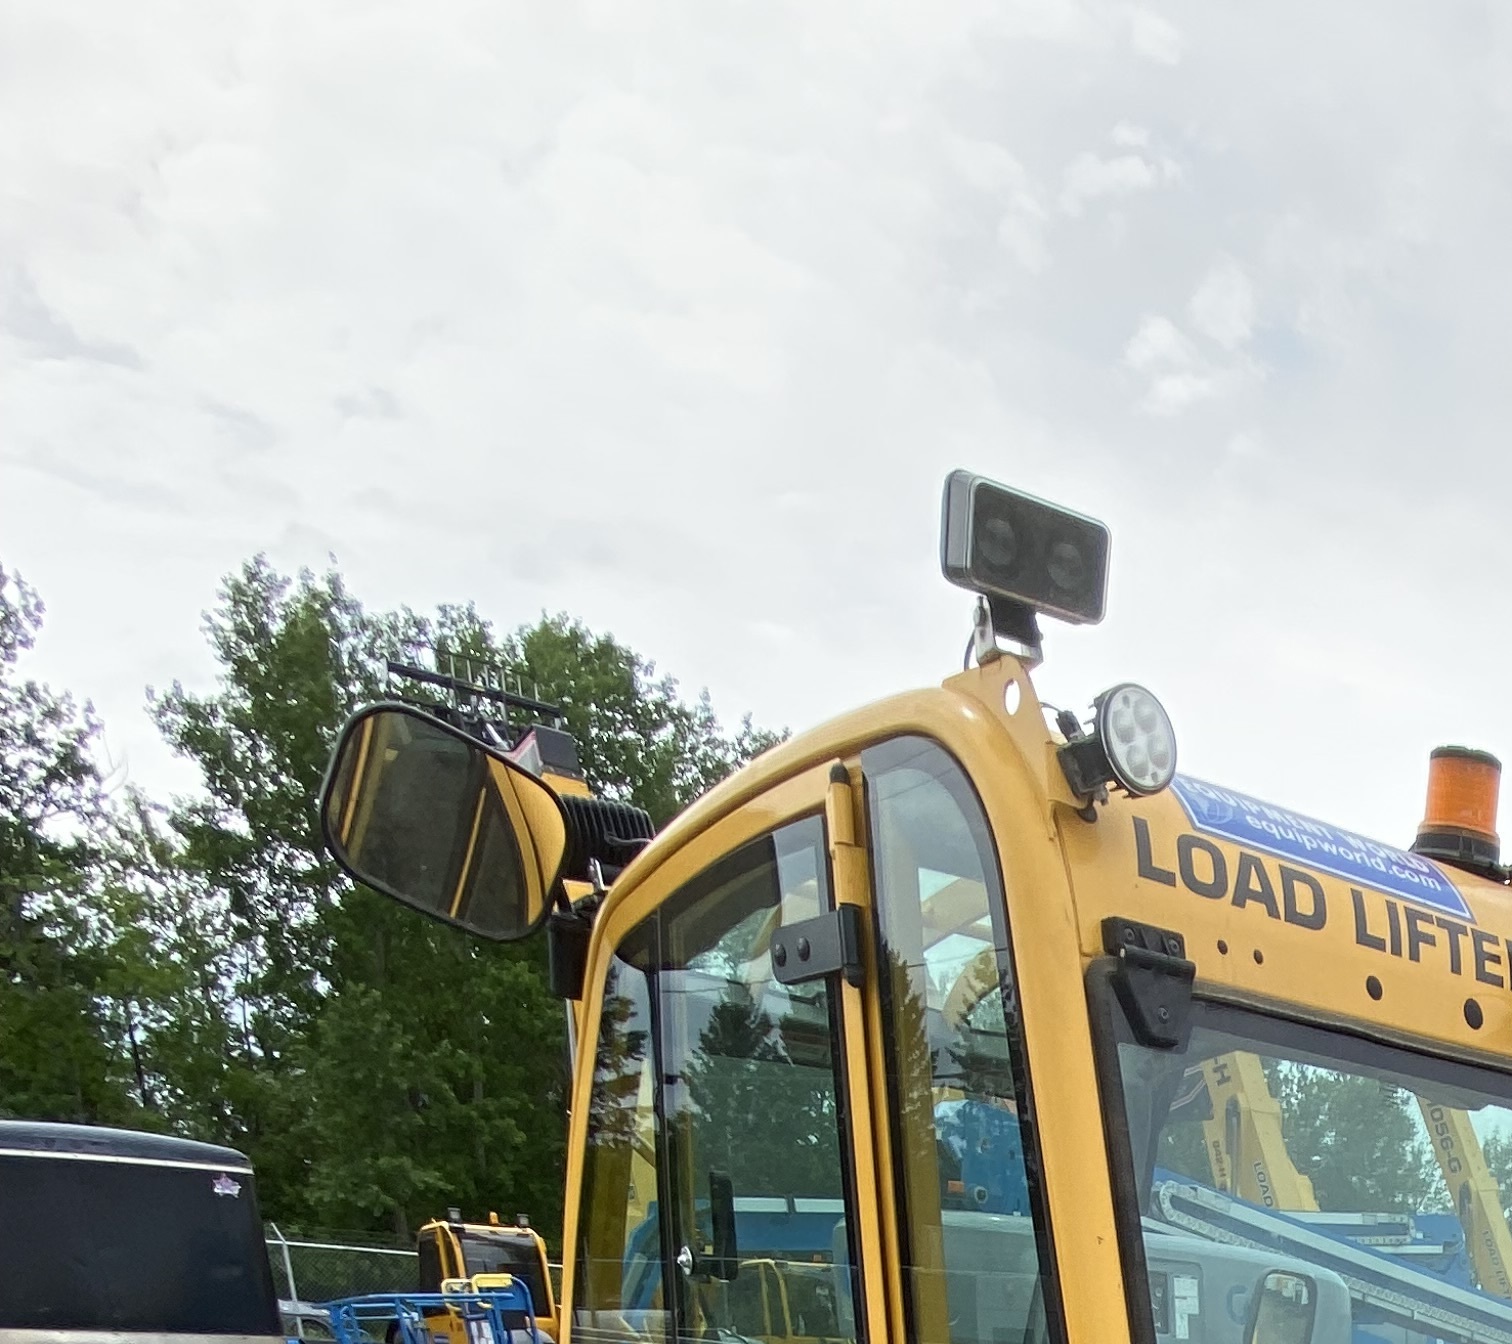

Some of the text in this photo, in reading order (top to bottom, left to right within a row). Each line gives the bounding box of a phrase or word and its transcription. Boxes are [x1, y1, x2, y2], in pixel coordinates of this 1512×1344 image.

[1184, 779, 1431, 874] EQUIPMENT WORLD
[1245, 814, 1442, 891] equipworld.com
[1132, 815, 1327, 931] LOAD
[1254, 1162, 1274, 1208] LOAD
